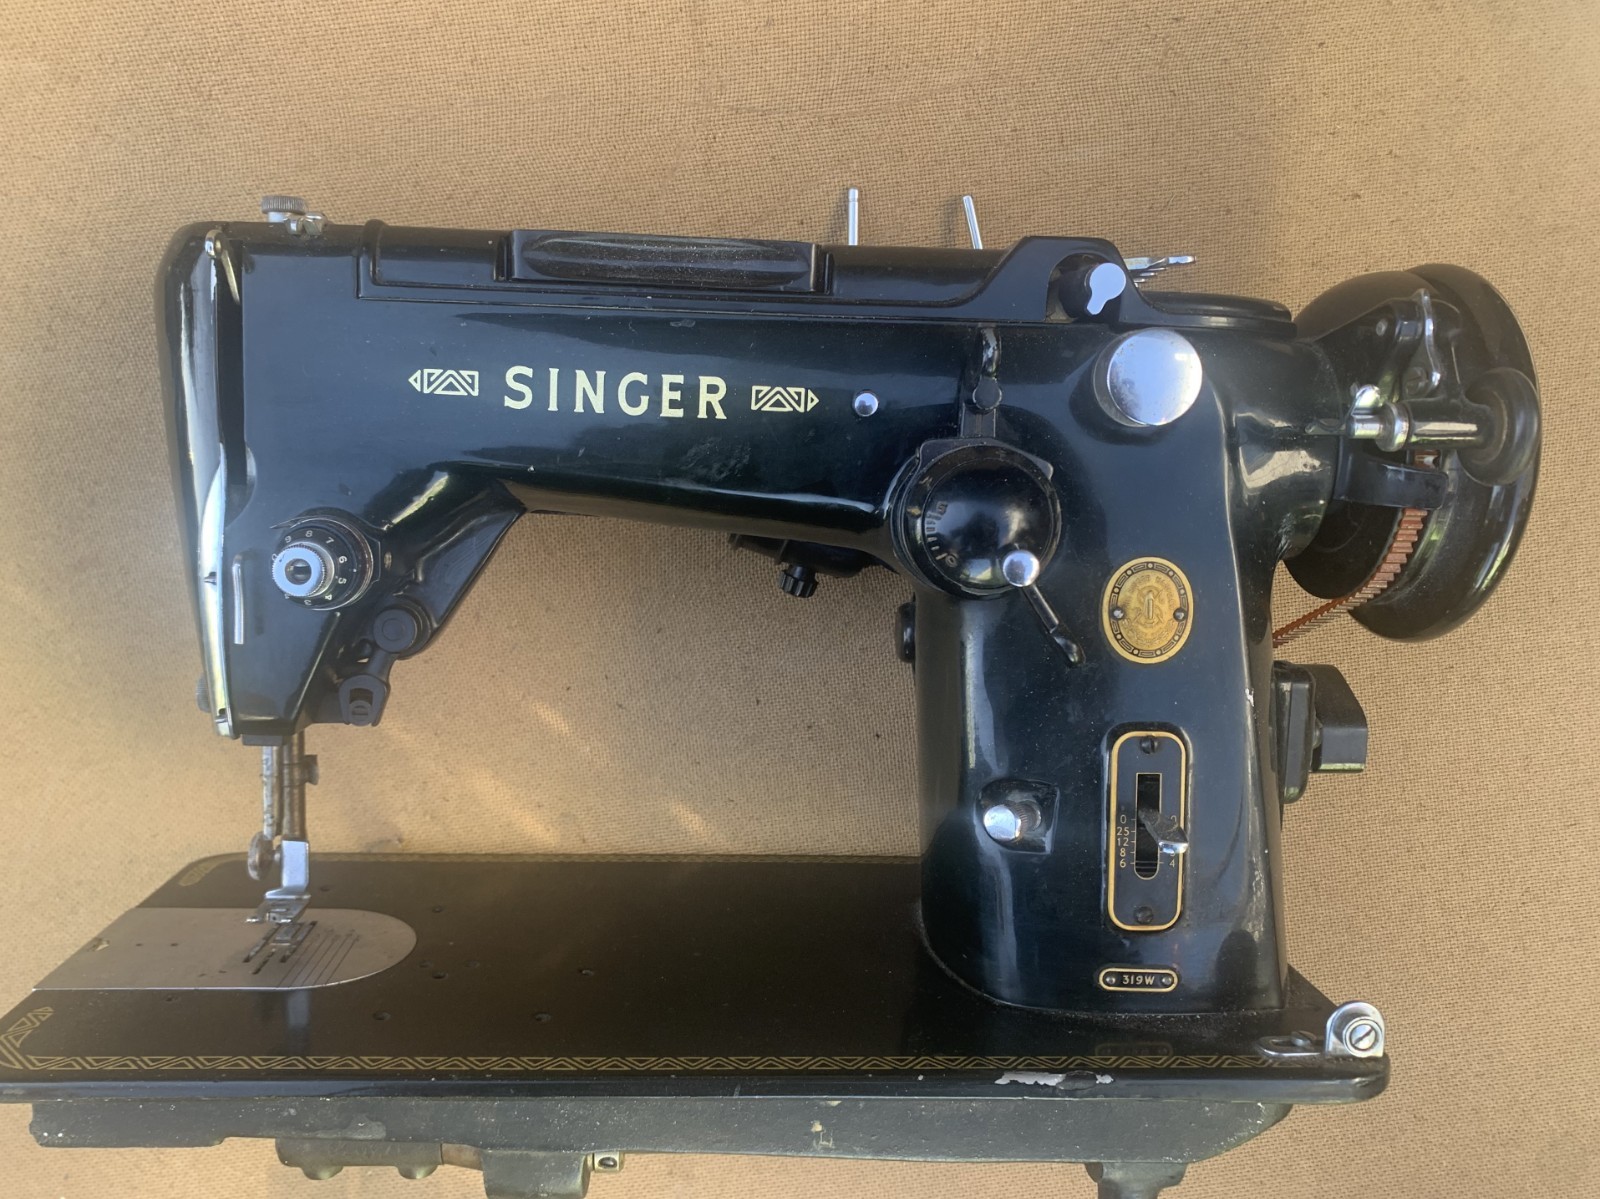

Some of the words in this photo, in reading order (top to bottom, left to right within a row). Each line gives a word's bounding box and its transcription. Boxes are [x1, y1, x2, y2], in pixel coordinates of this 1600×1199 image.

[504, 365, 728, 419] SINGER
[284, 535, 291, 543] 9
[305, 530, 313, 538] 8
[325, 536, 334, 544] 7
[338, 577, 347, 585] 5
[1120, 814, 1127, 824] 0
[1116, 826, 1130, 836] 25
[1117, 837, 1129, 847] 12
[1119, 847, 1126, 857] 8
[1119, 858, 1127, 868] 6
[1169, 858, 1175, 868] 4
[1122, 974, 1155, 985] 319W
